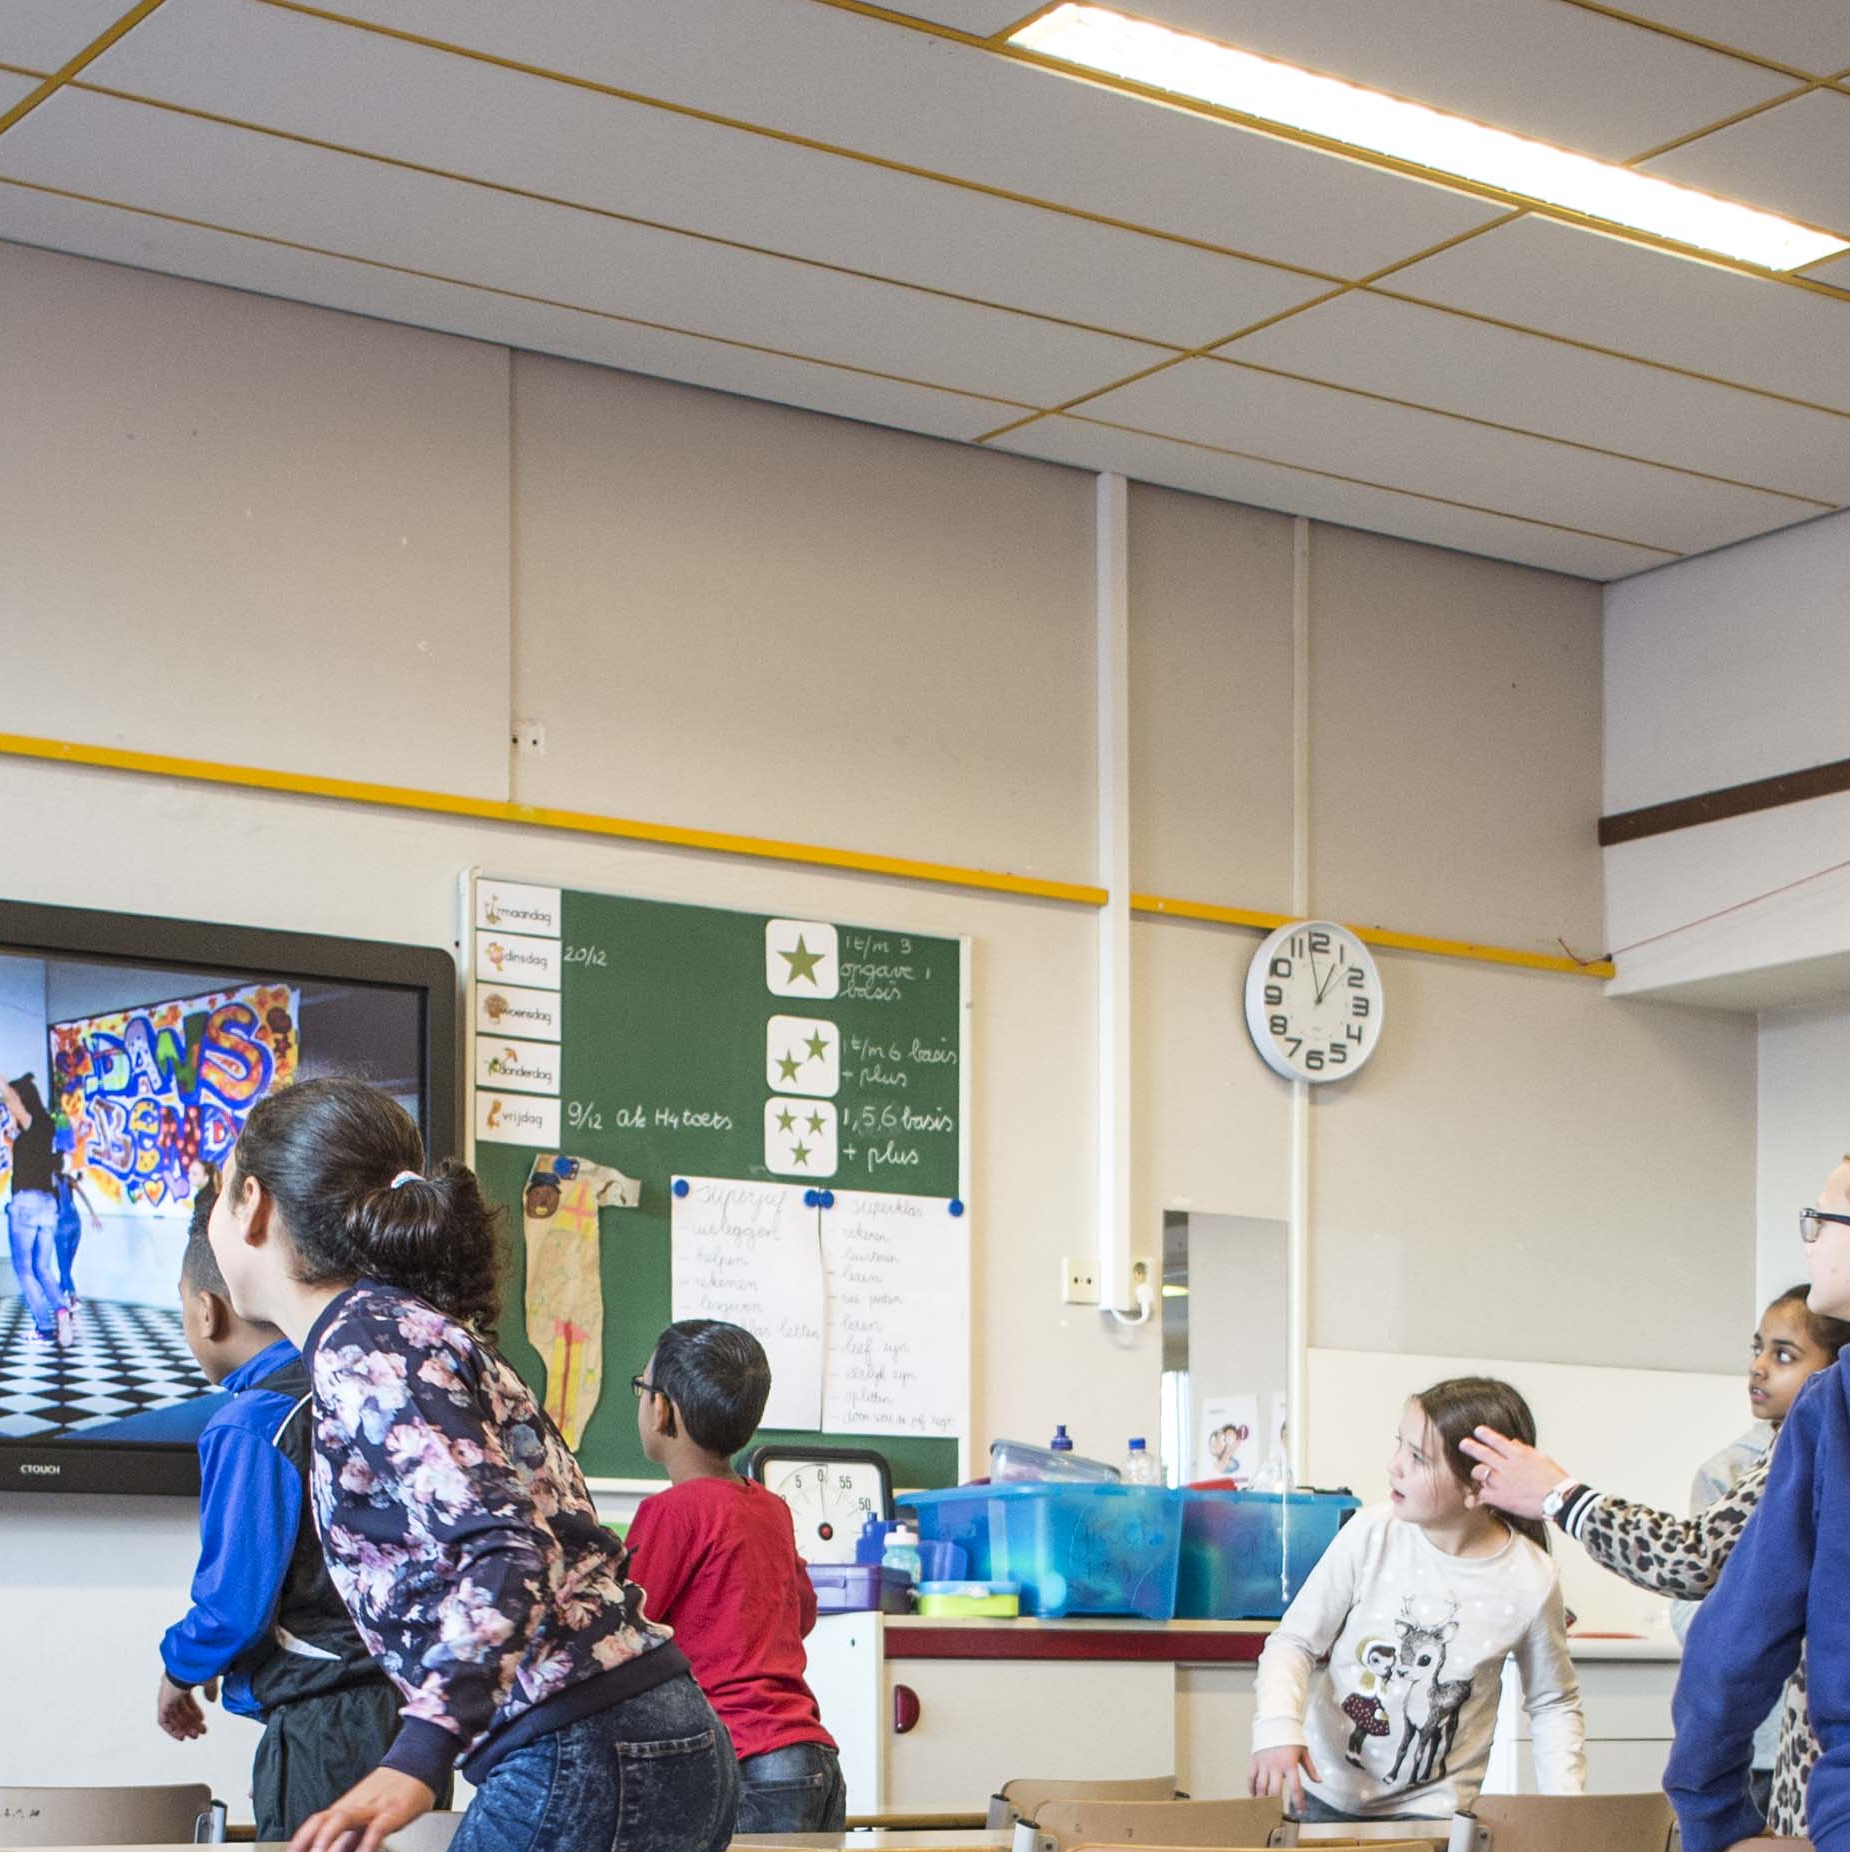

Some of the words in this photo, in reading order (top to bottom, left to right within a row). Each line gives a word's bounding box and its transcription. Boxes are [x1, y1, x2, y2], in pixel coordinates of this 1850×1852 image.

[497, 906, 552, 927] maandag
[900, 938, 912, 955] 3
[1290, 937, 1303, 958] 11
[1339, 944, 1344, 964] 1
[505, 951, 548, 970] dinsdag
[1269, 957, 1292, 978] 10
[1347, 967, 1364, 988] 2
[1264, 985, 1283, 1006] 9
[500, 1007, 552, 1025] woensdag
[1352, 996, 1369, 1017] 3
[1269, 1014, 1288, 1036] 8
[1346, 1024, 1363, 1045] 4
[83, 1003, 276, 1110] DANS
[907, 1037, 957, 1065] basis
[1284, 1036, 1302, 1058] 7
[1329, 1042, 1347, 1064] 5
[1305, 1050, 1324, 1071] 6
[499, 1064, 553, 1084] donderdag
[859, 1063, 908, 1088] plus
[503, 1111, 544, 1128] vrijdag
[901, 1105, 953, 1132] basis
[867, 1139, 920, 1174] plus
[20, 1464, 61, 1475] CTOUCH
[817, 1469, 824, 1482] 0
[794, 1475, 802, 1488] 5
[839, 1475, 853, 1489] 55
[858, 1497, 872, 1511] 50
